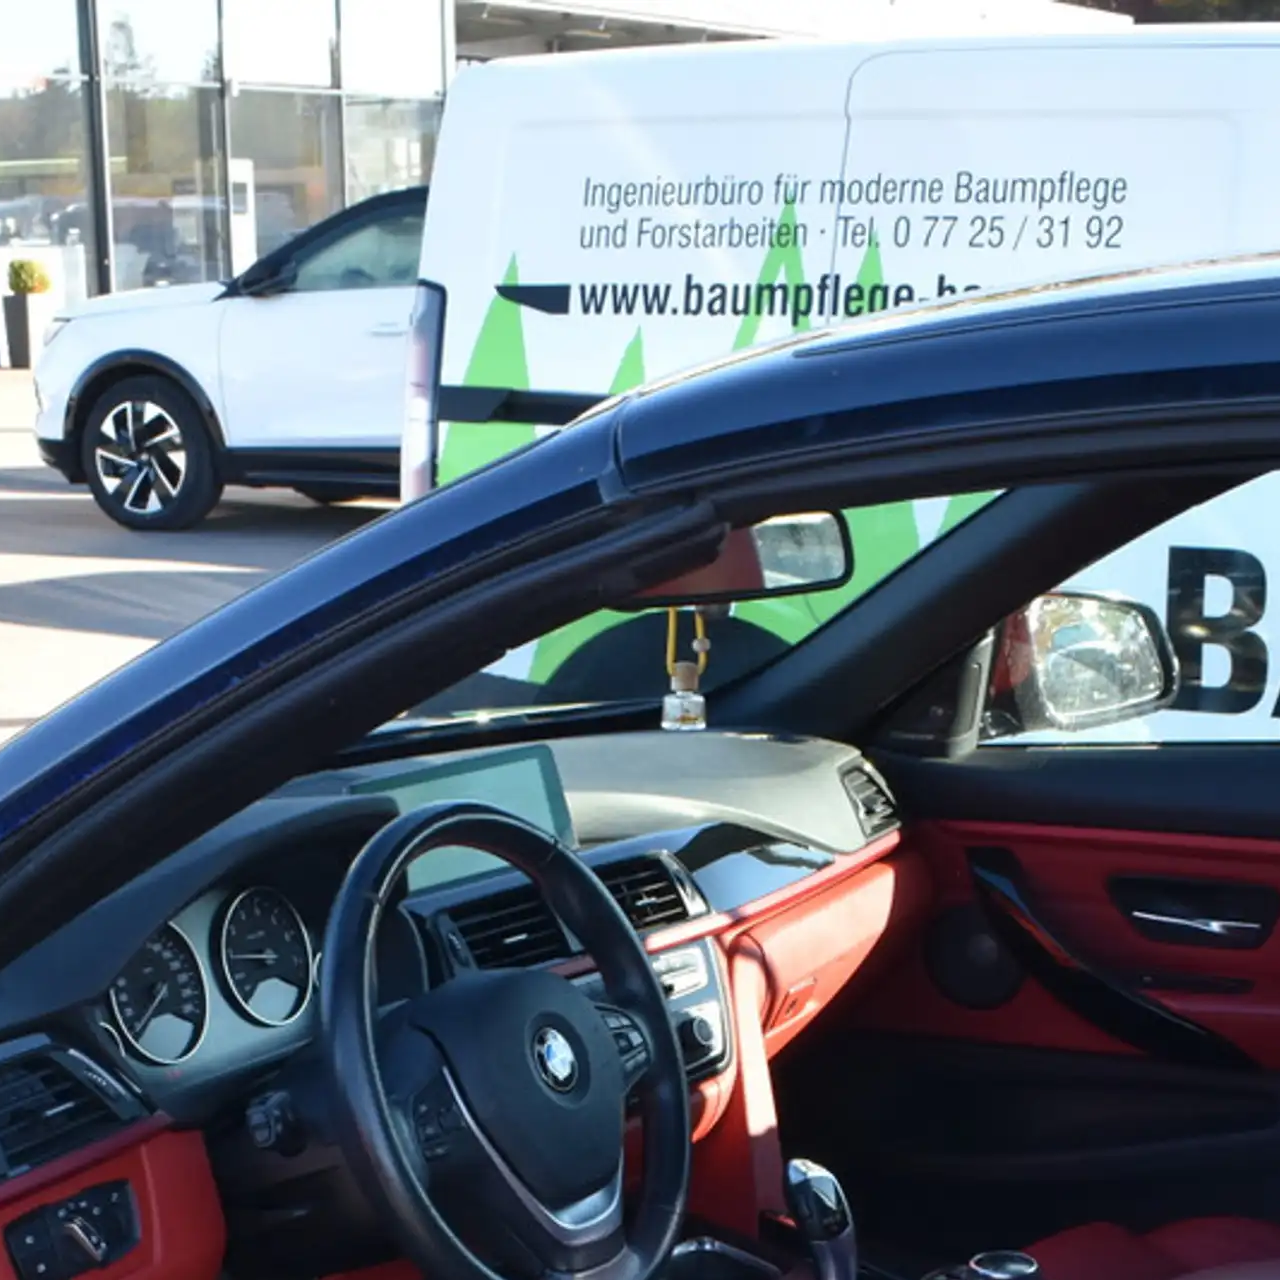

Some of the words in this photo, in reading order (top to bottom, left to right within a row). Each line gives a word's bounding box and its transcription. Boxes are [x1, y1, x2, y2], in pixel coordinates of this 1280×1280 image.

[582, 175, 764, 214] Ingenieurbüro
[772, 173, 811, 206] für
[819, 173, 944, 206] moderne
[954, 170, 1127, 211] Baumpflege
[579, 217, 629, 250] und
[636, 216, 809, 250] Forstarbeiten
[837, 215, 880, 249] Tel.
[893, 215, 911, 249] 0
[923, 215, 959, 249] 77
[969, 215, 1005, 249] 25
[1012, 215, 1029, 251] /
[1036, 215, 1071, 249] 31
[1085, 215, 1124, 249] 92
